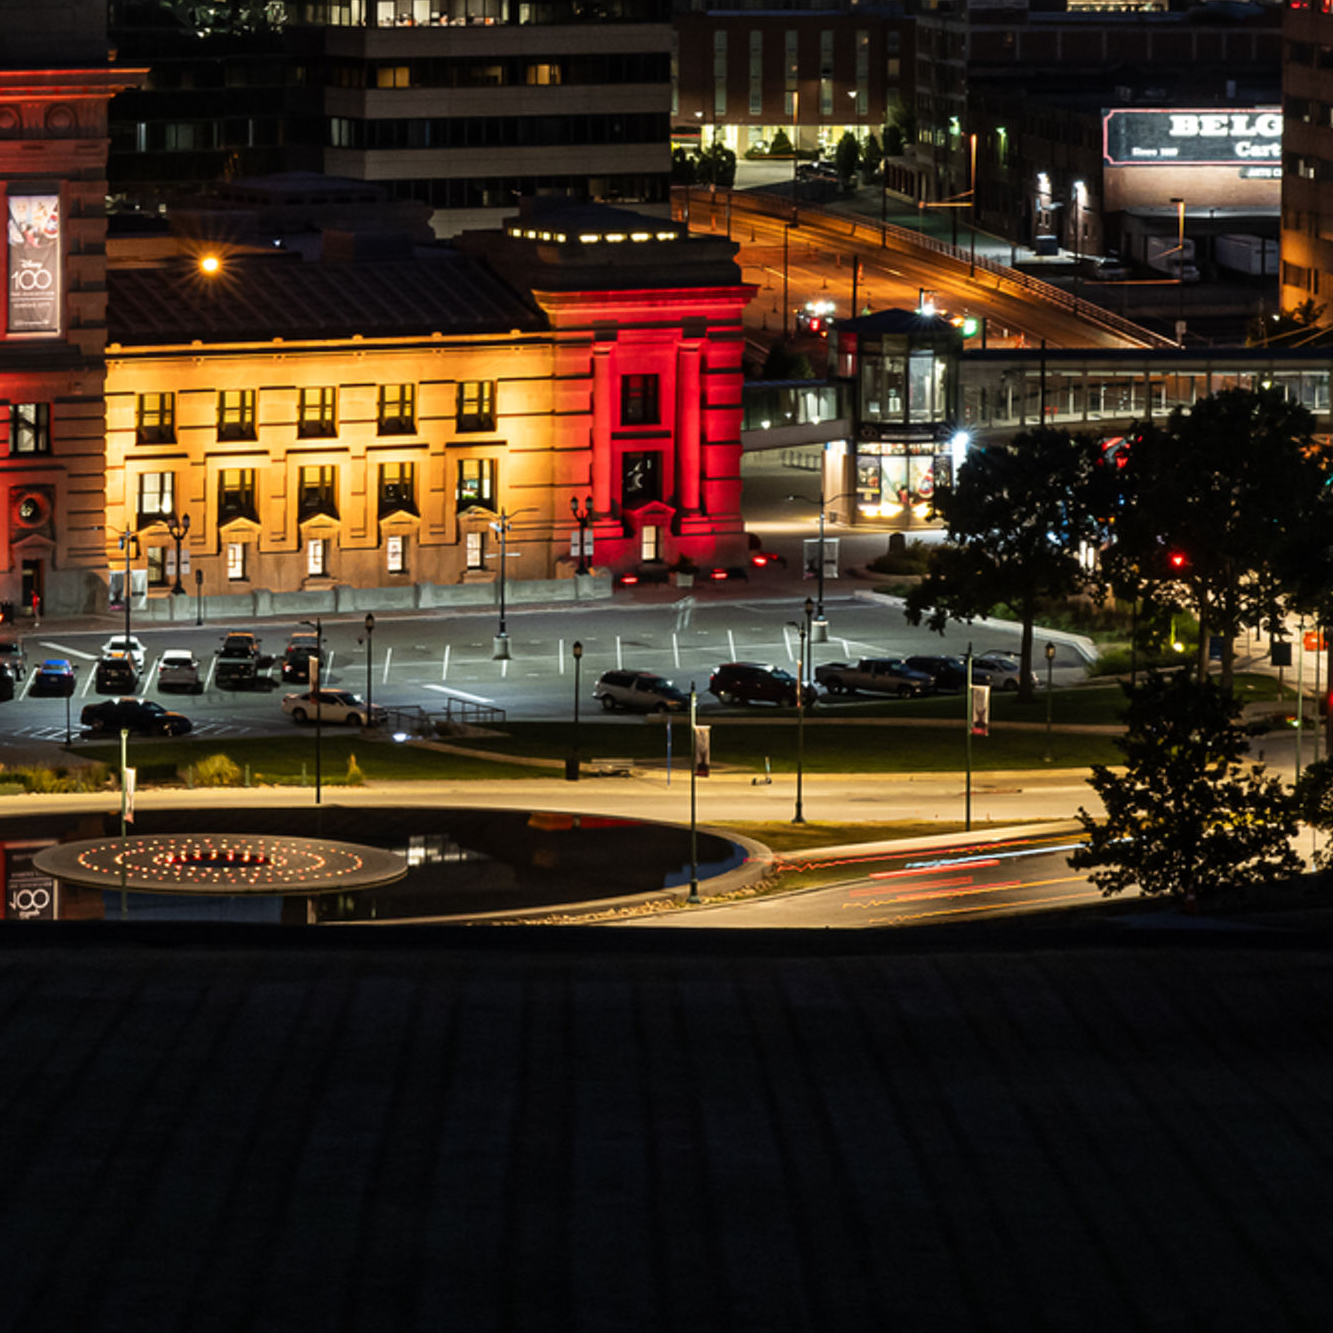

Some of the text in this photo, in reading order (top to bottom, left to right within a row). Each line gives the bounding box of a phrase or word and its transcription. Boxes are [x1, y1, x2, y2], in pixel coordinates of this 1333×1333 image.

[1169, 114, 1282, 136] BELG
[1235, 141, 1281, 157] Cart
[12, 269, 52, 290] 100
